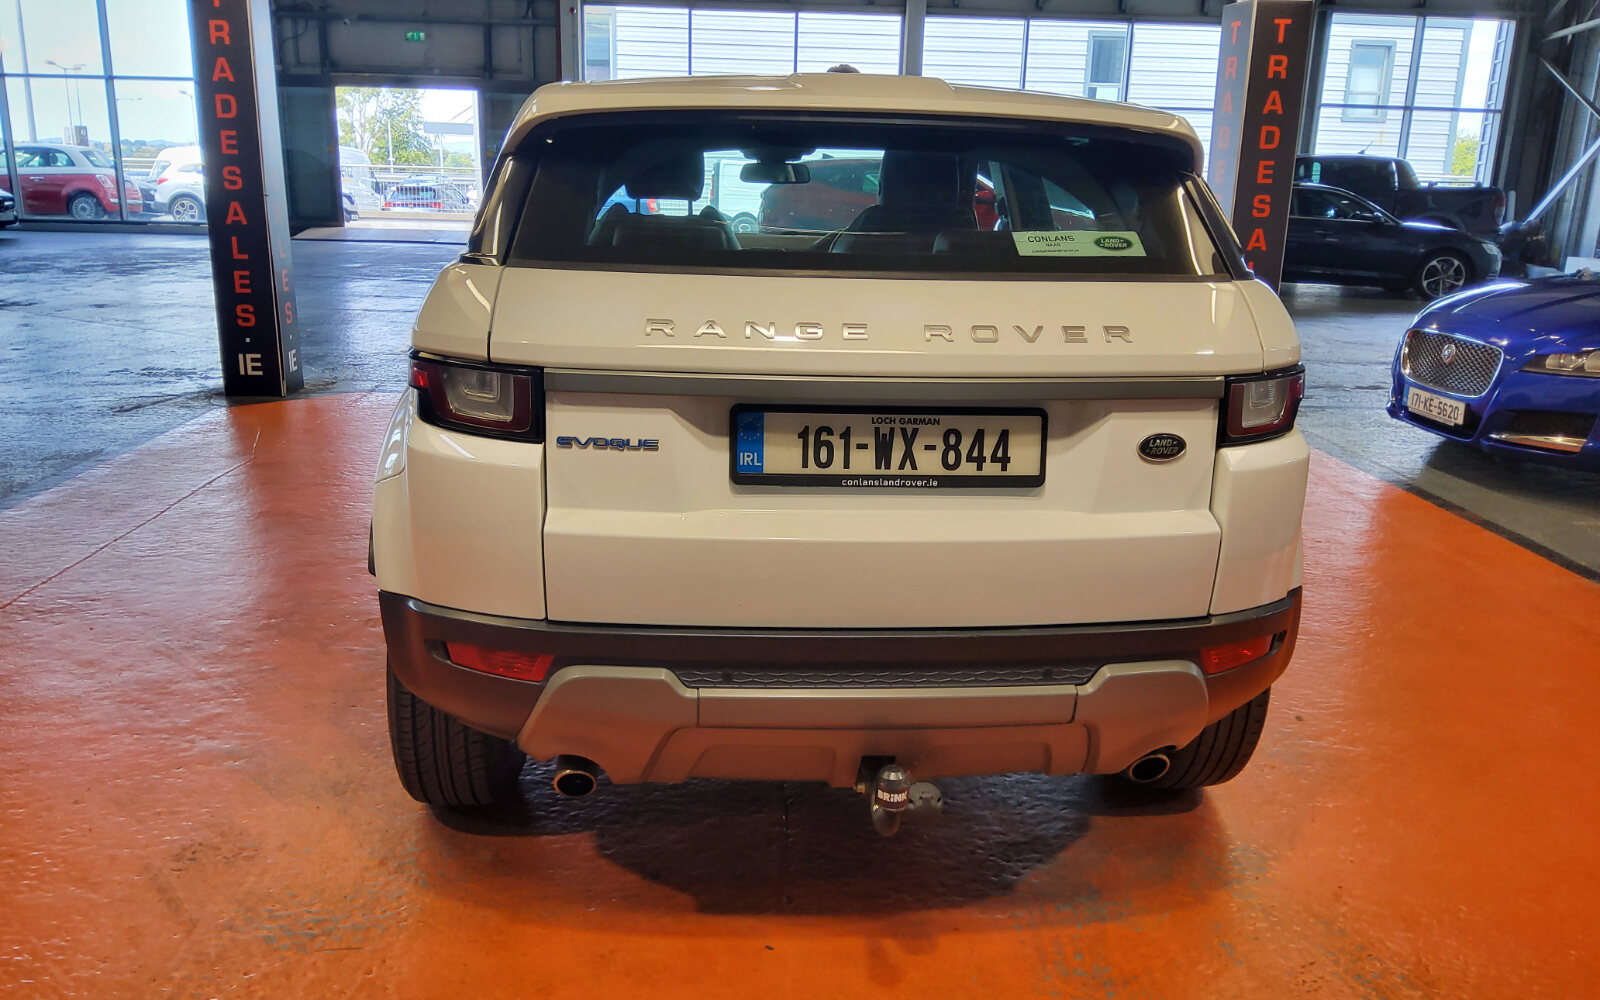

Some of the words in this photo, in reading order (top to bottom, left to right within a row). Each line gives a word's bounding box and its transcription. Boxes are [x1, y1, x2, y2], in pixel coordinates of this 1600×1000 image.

[1027, 235, 1075, 243] CONLANS
[644, 318, 869, 340] RANGE
[923, 324, 1133, 343] ROVER
[1411, 391, 1460, 421] 171-KE-5620
[871, 416, 896, 425] LOCH
[899, 417, 940, 426] GARMAN
[556, 436, 660, 451] EVOQUE
[797, 425, 1011, 472] 161-WX-844
[739, 452, 762, 467] IRL
[841, 477, 938, 487] conlanslandrover.ie
